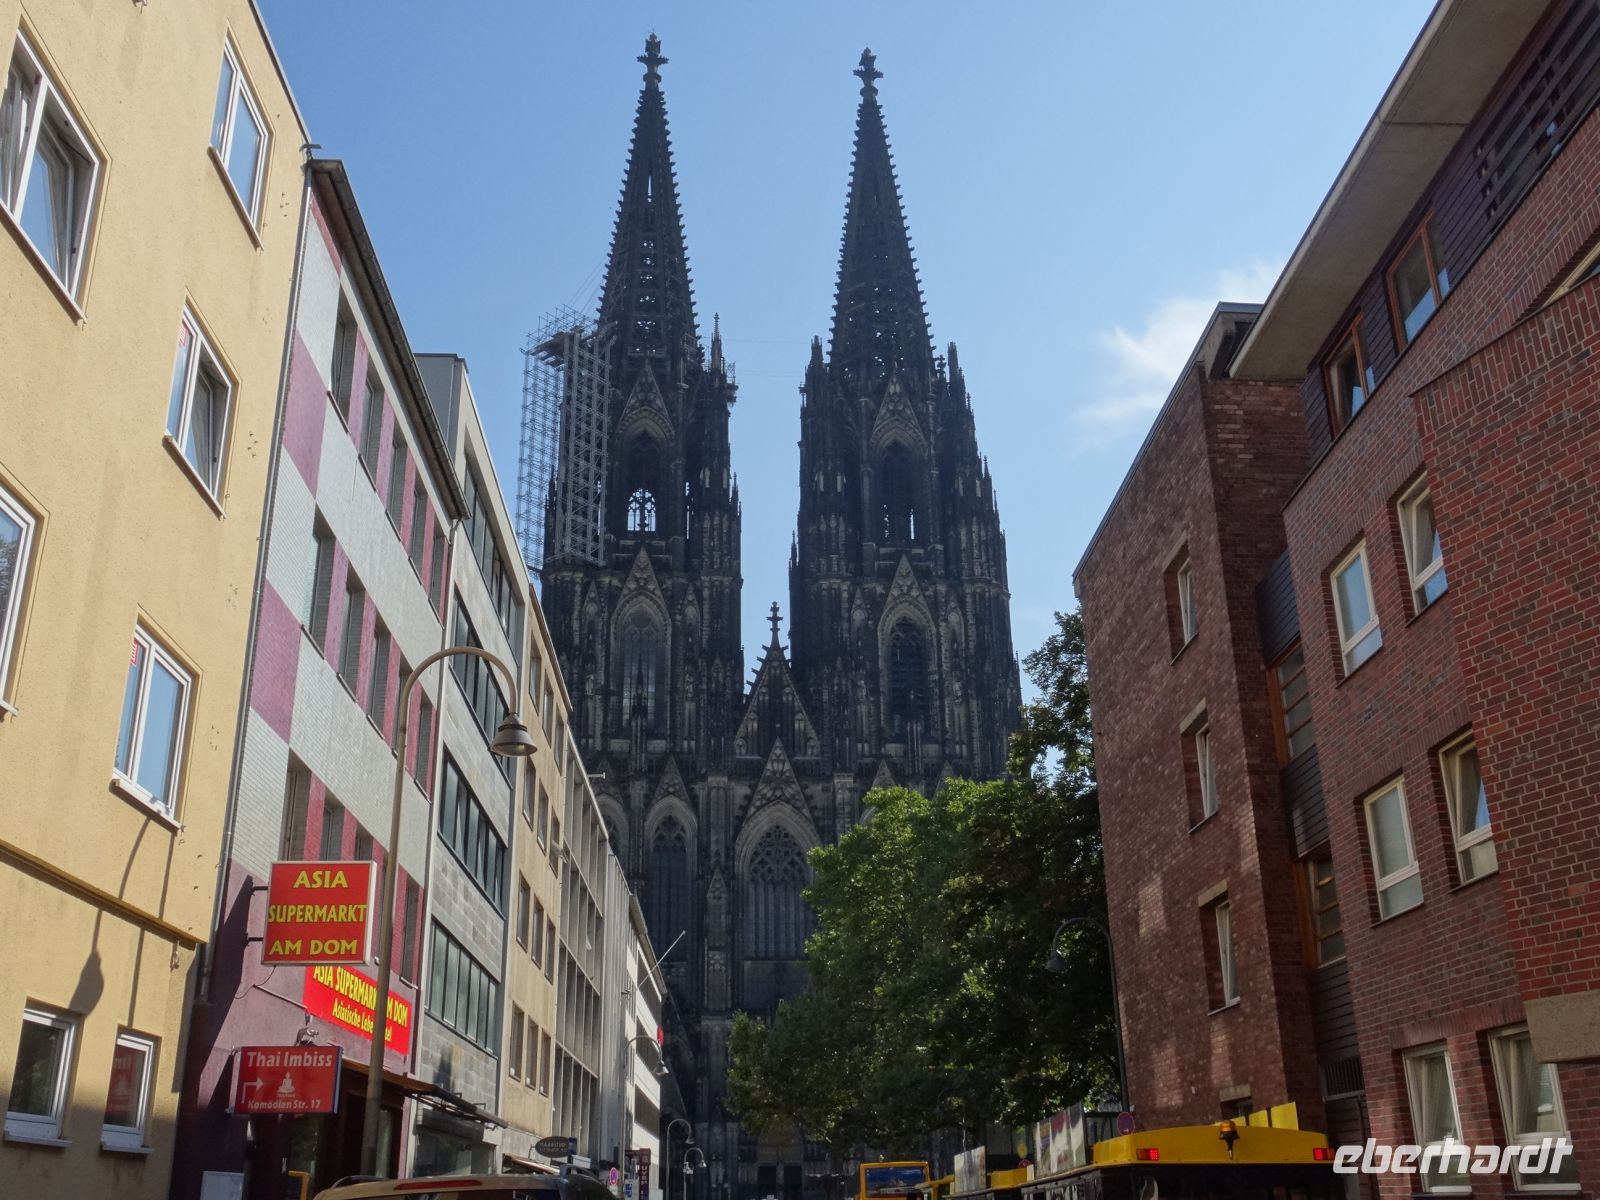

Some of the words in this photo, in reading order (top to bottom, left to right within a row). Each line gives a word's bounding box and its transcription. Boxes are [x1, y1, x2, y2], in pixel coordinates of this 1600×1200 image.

[293, 870, 349, 889] ASIA
[267, 904, 368, 923] SUPERMARKT
[268, 940, 302, 955] AM
[309, 939, 358, 956] DOM
[313, 965, 334, 989] ASIA
[393, 999, 409, 1028] DOM
[332, 997, 361, 1029] Asiatische
[247, 1051, 281, 1068] Thai
[283, 1050, 333, 1068] Imbiss
[292, 1099, 309, 1109] Str.
[311, 1099, 320, 1109] 17
